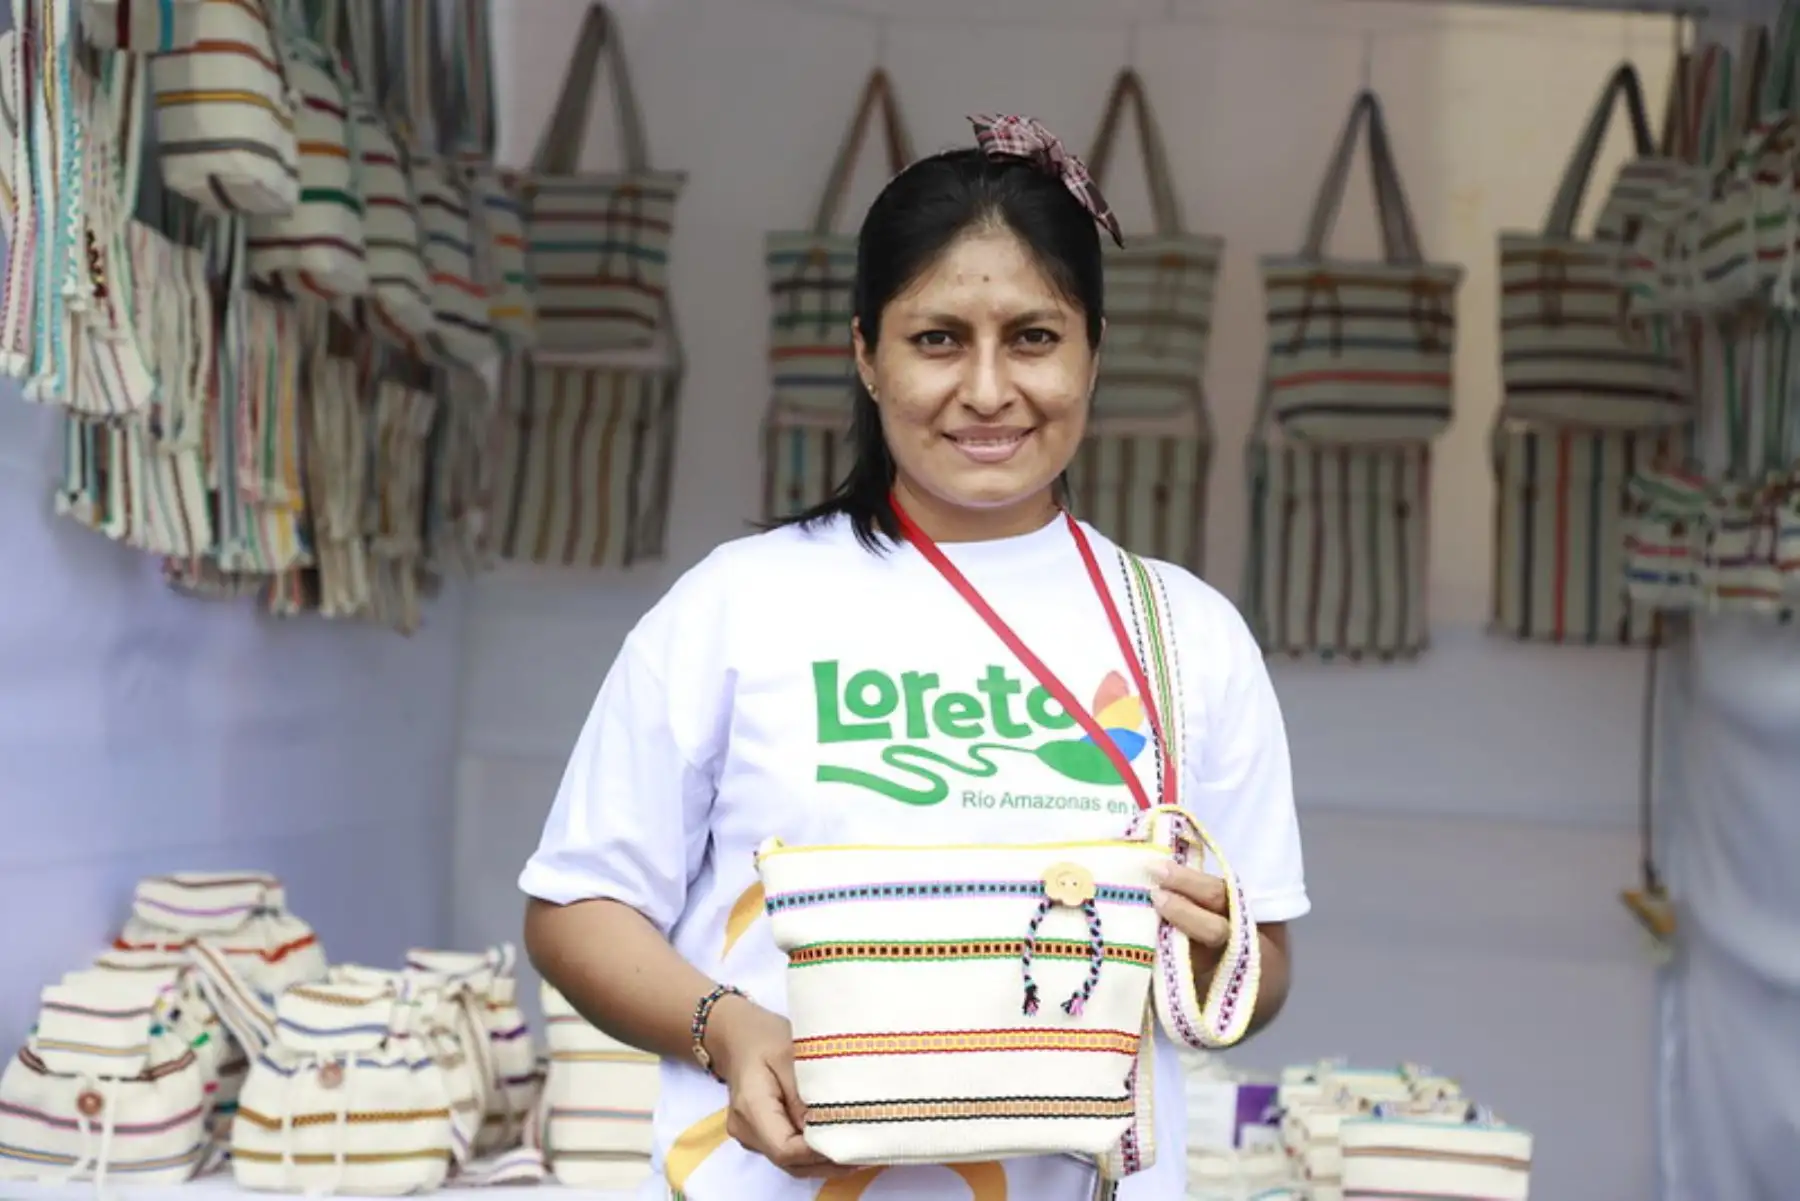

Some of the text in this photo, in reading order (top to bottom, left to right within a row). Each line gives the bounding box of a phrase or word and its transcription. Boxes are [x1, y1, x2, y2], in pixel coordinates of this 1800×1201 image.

[812, 660, 1079, 744] Loreto
[1000, 791, 1101, 811] Amazonas
[1107, 800, 1128, 814] en
